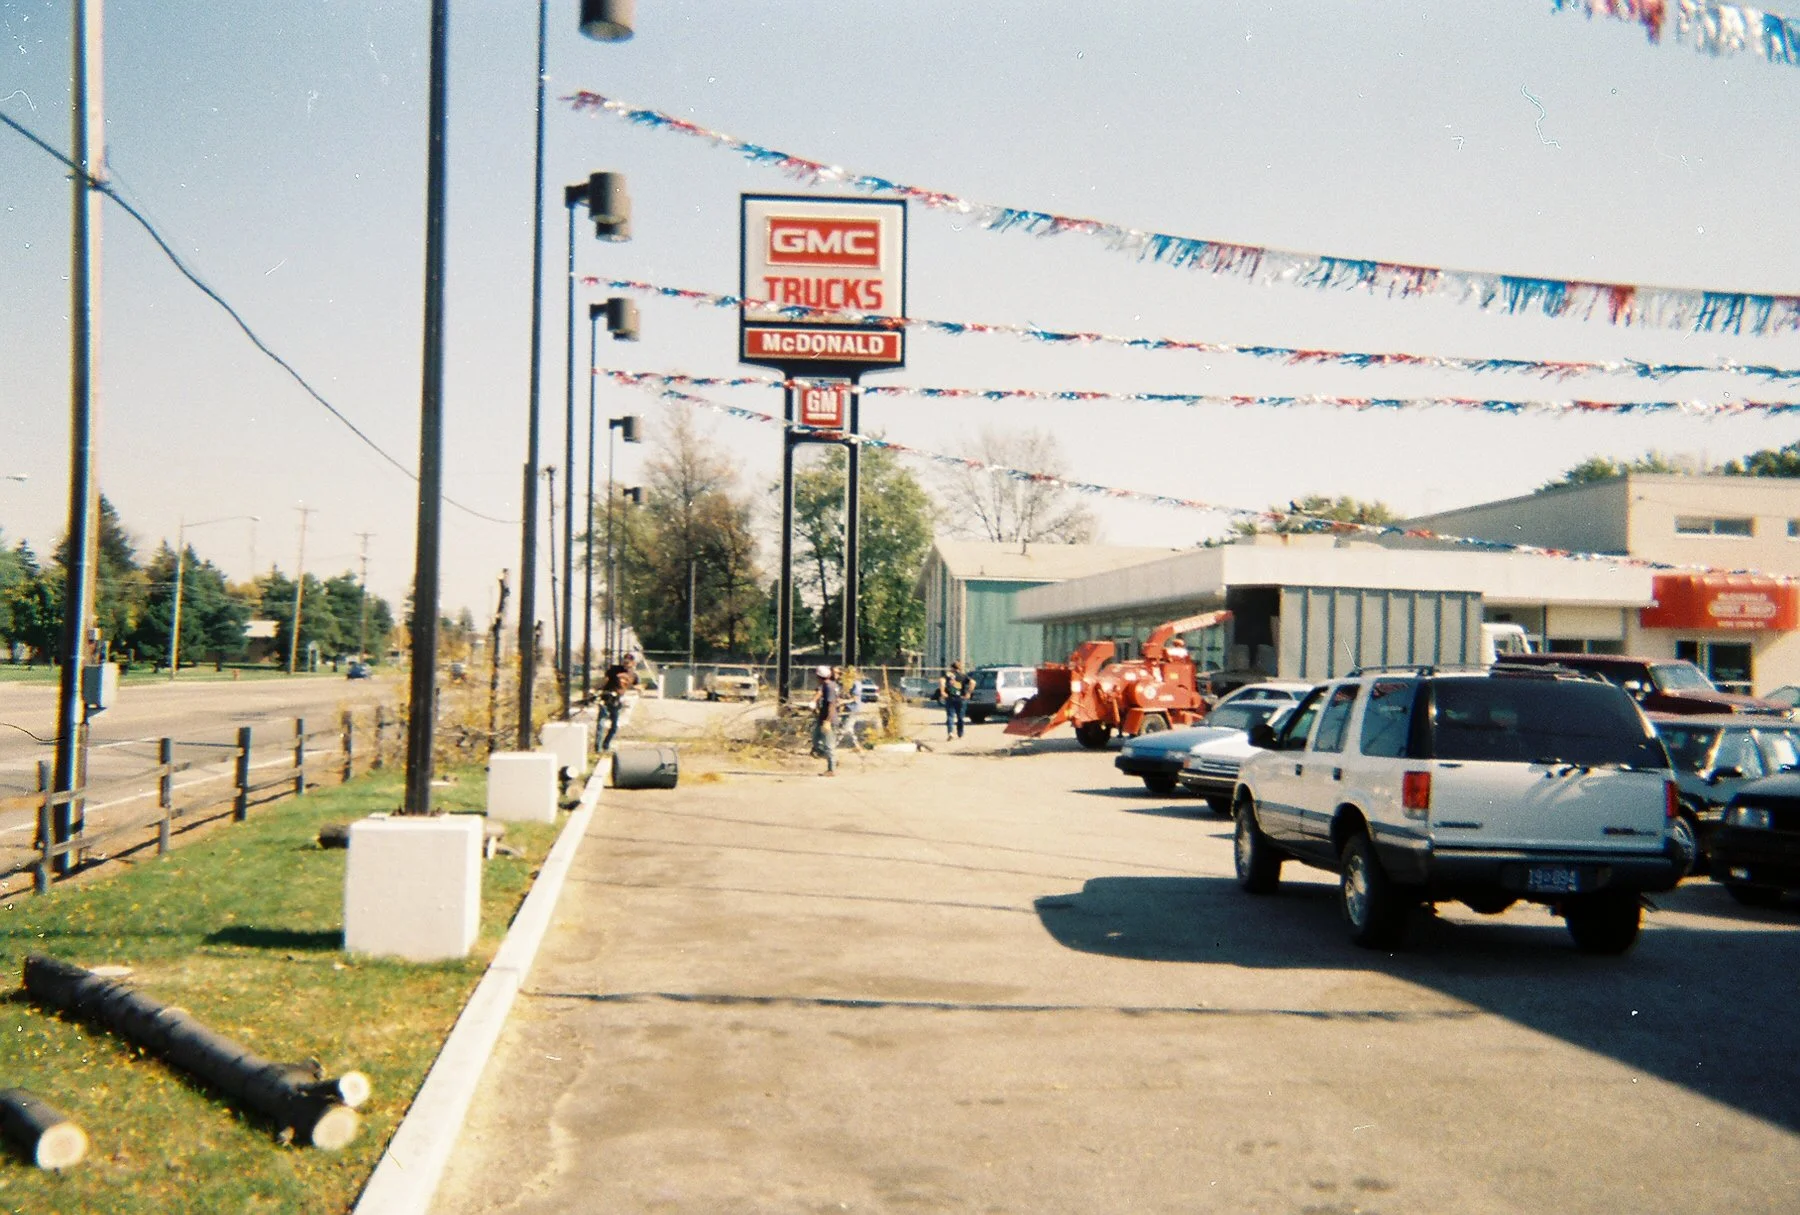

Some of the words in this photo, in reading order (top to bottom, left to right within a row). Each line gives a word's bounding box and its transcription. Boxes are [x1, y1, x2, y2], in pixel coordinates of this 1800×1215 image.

[772, 227, 876, 256] GMC
[763, 275, 883, 311] TRUCKS
[762, 333, 885, 354] McDONALD
[806, 389, 838, 413] GM
